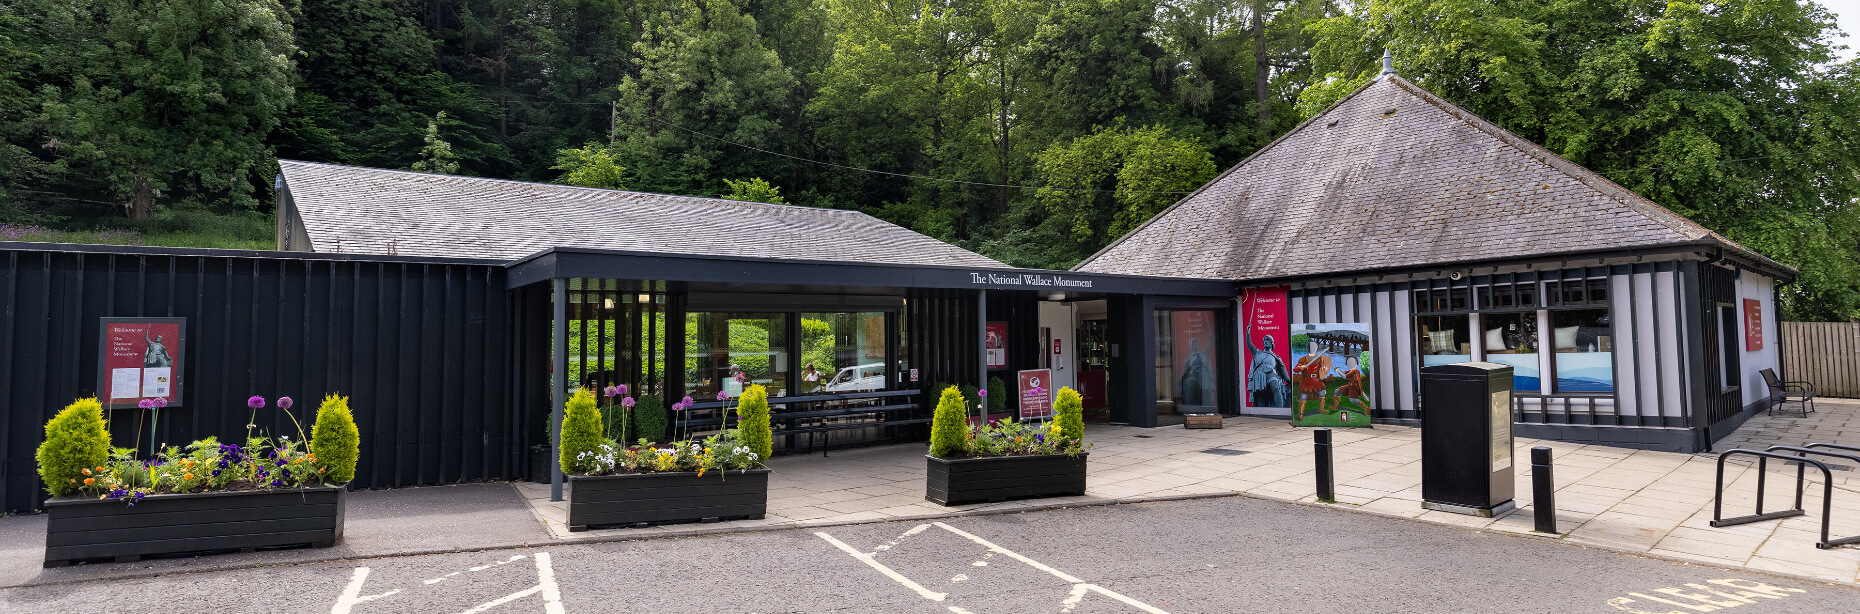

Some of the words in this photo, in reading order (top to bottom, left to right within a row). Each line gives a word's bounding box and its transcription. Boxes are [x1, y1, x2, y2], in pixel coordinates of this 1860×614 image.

[970, 272, 986, 284] The
[988, 273, 1022, 285] National
[1023, 274, 1052, 286] Wallace
[1053, 275, 1093, 288] Monument
[1607, 578, 1807, 614] CLEAR
